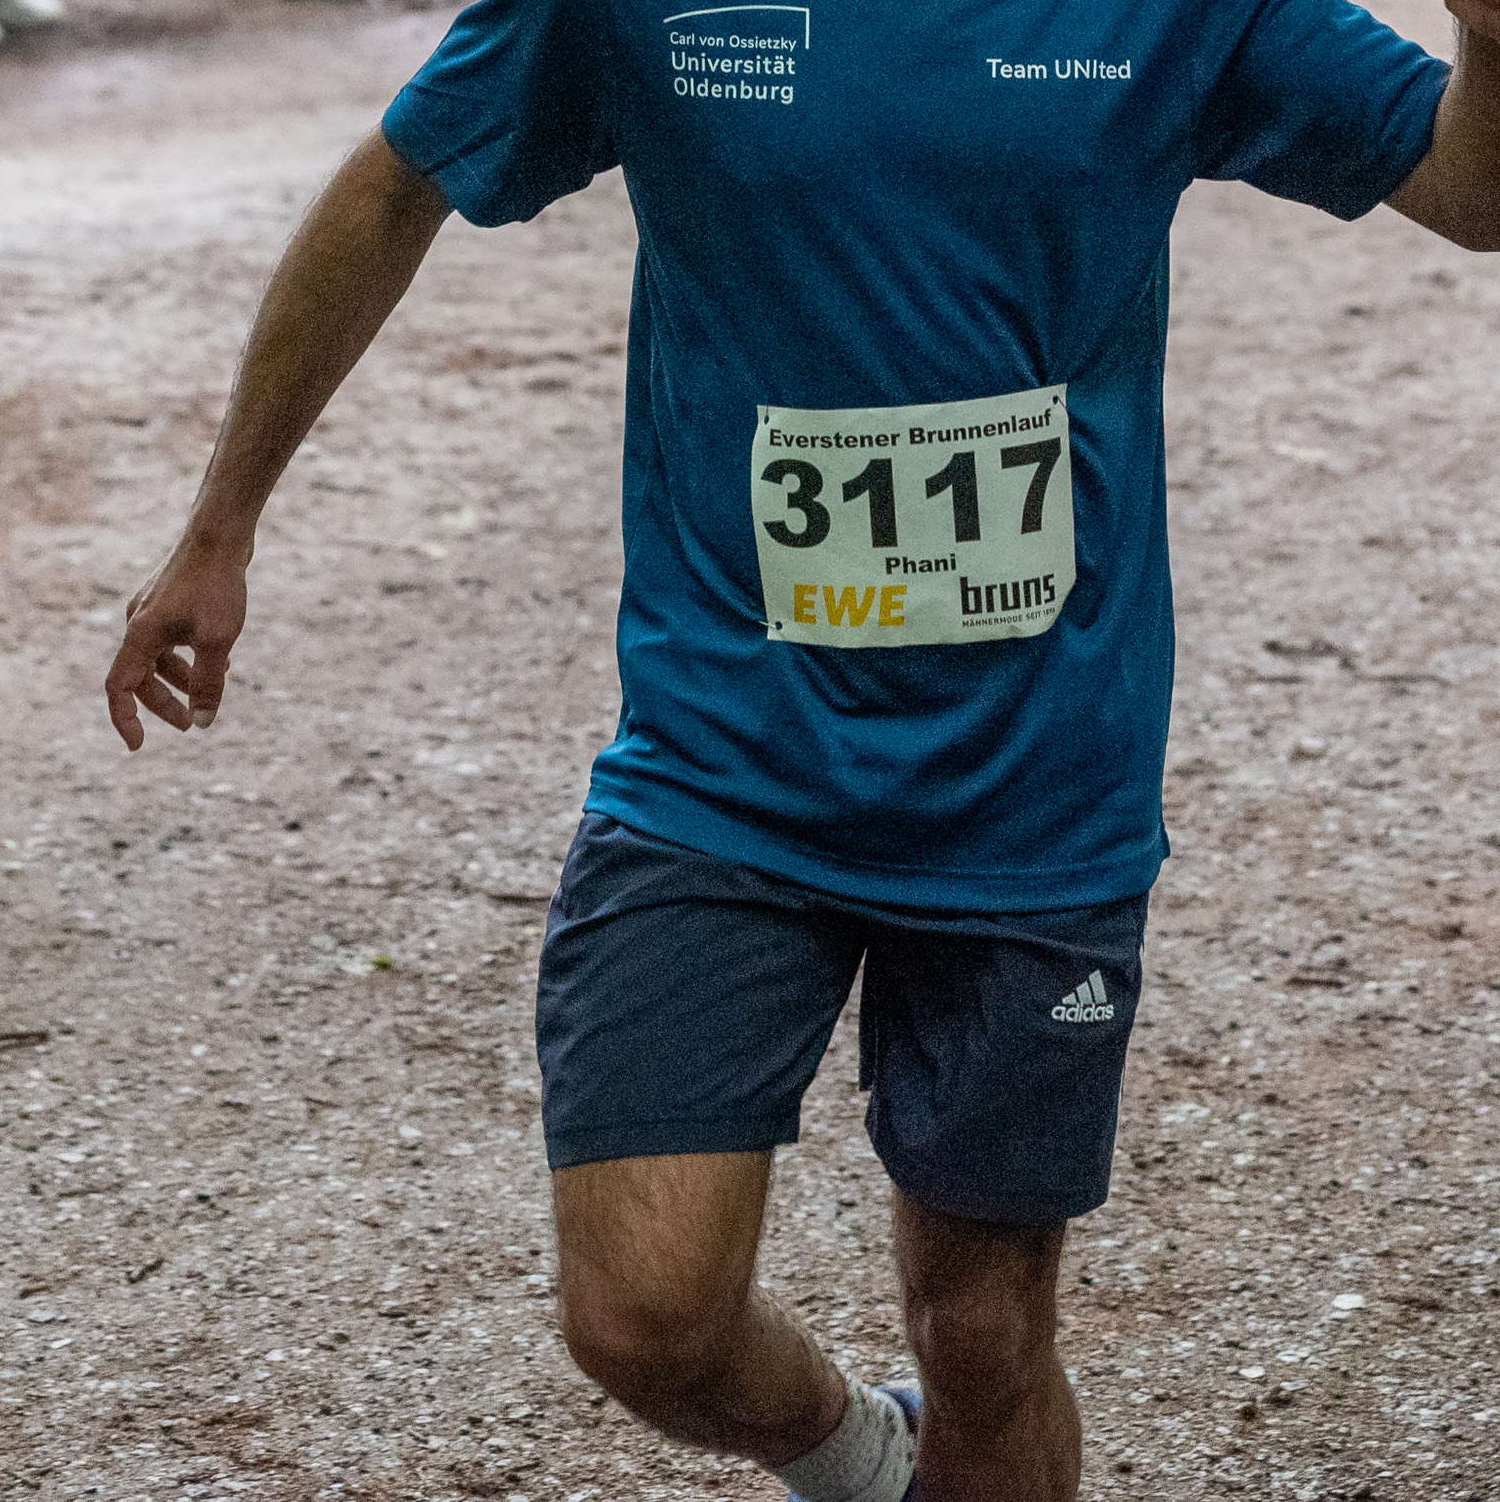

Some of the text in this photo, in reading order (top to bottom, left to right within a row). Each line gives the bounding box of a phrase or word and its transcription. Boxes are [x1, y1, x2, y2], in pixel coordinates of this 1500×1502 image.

[669, 31, 797, 52] Carl von Ossietzky
[671, 51, 796, 75] Universität
[986, 58, 1132, 80] Team UNIted
[673, 77, 794, 104] Oldenburg
[769, 408, 1052, 449] Everstener Brunnenlauf
[760, 436, 1062, 549] 3117
[885, 553, 957, 575] Phani
[793, 583, 907, 627] EWE
[960, 573, 1056, 615] bruns
[1025, 611, 1041, 620] SEIT
[1051, 1003, 1115, 1023] adidas
